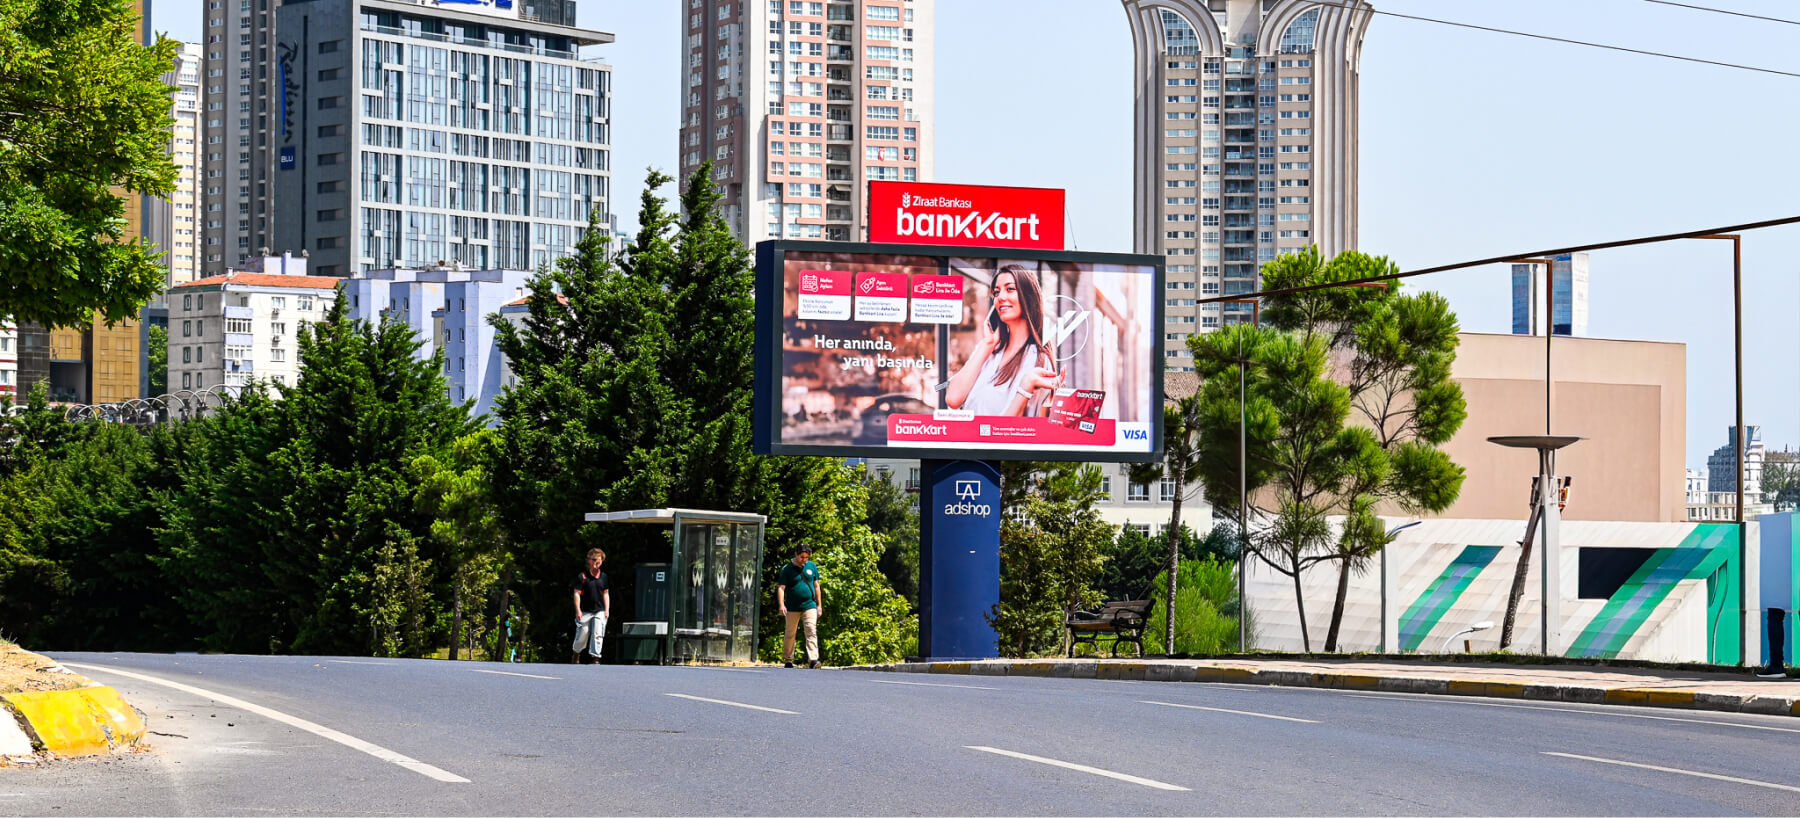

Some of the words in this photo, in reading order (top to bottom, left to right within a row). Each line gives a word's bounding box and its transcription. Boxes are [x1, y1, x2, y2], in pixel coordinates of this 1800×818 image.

[281, 155, 294, 163] BLU
[912, 195, 938, 207] Ziraat
[939, 197, 972, 209] Bankası
[814, 335, 840, 349] Her
[843, 336, 896, 352] anında,
[842, 357, 874, 370] yanı
[877, 353, 933, 370] başında
[1123, 429, 1148, 440] VISA
[944, 501, 991, 518] adshop
